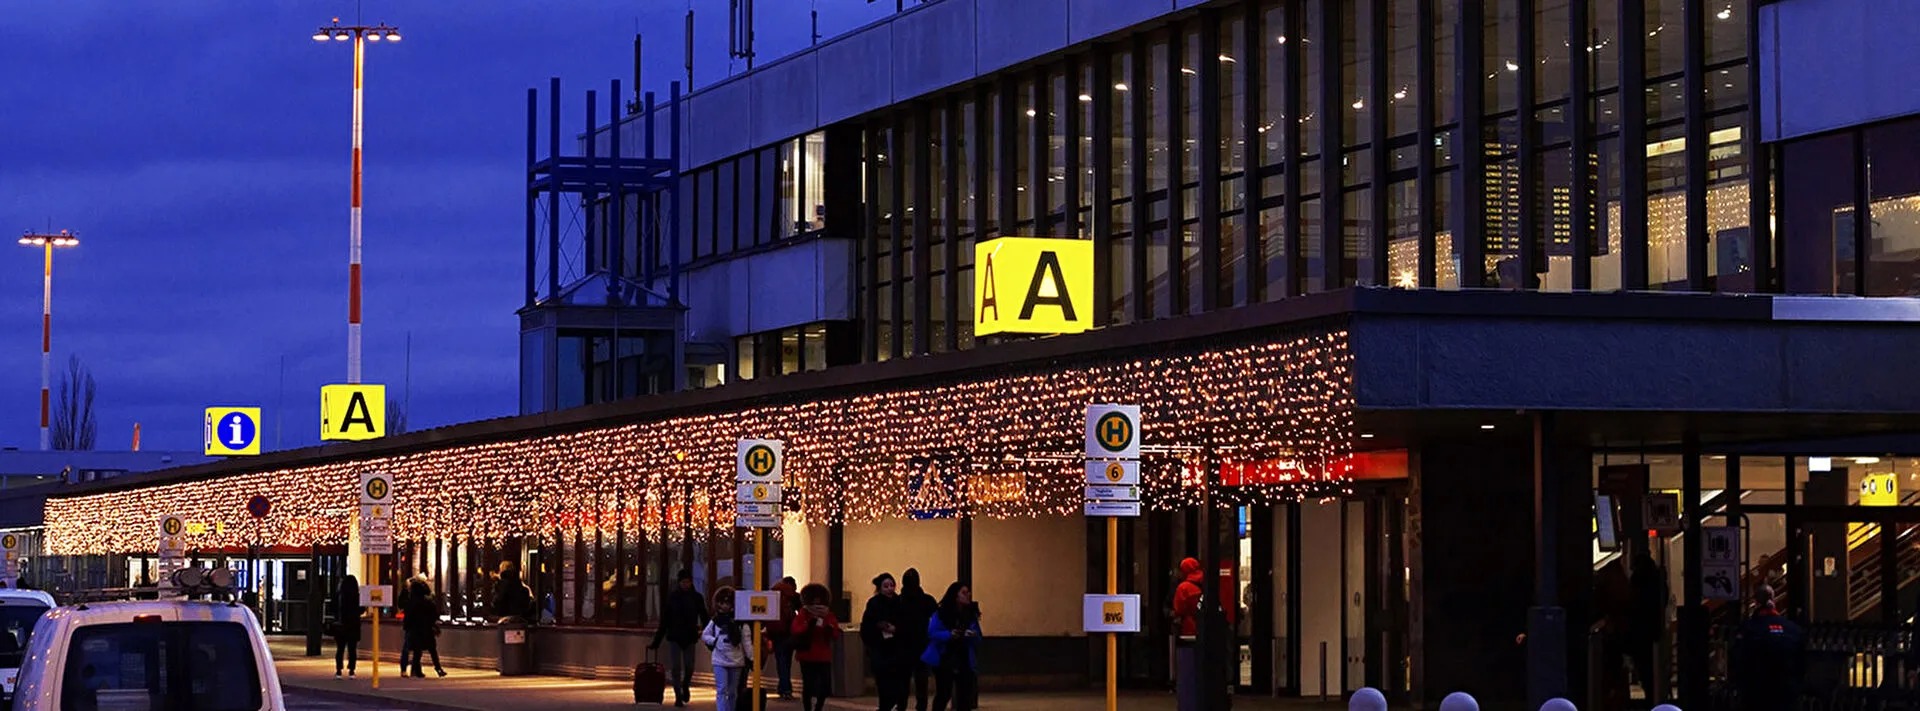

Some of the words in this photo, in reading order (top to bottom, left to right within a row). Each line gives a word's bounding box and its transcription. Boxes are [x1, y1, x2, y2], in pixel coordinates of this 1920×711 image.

[980, 252, 998, 324] A
[1018, 250, 1077, 321] A
[340, 391, 375, 432] A
[1106, 421, 1124, 442] H
[754, 452, 768, 469] H
[1110, 466, 1119, 479] 6
[372, 482, 383, 495] H
[1104, 612, 1122, 622] BVG
